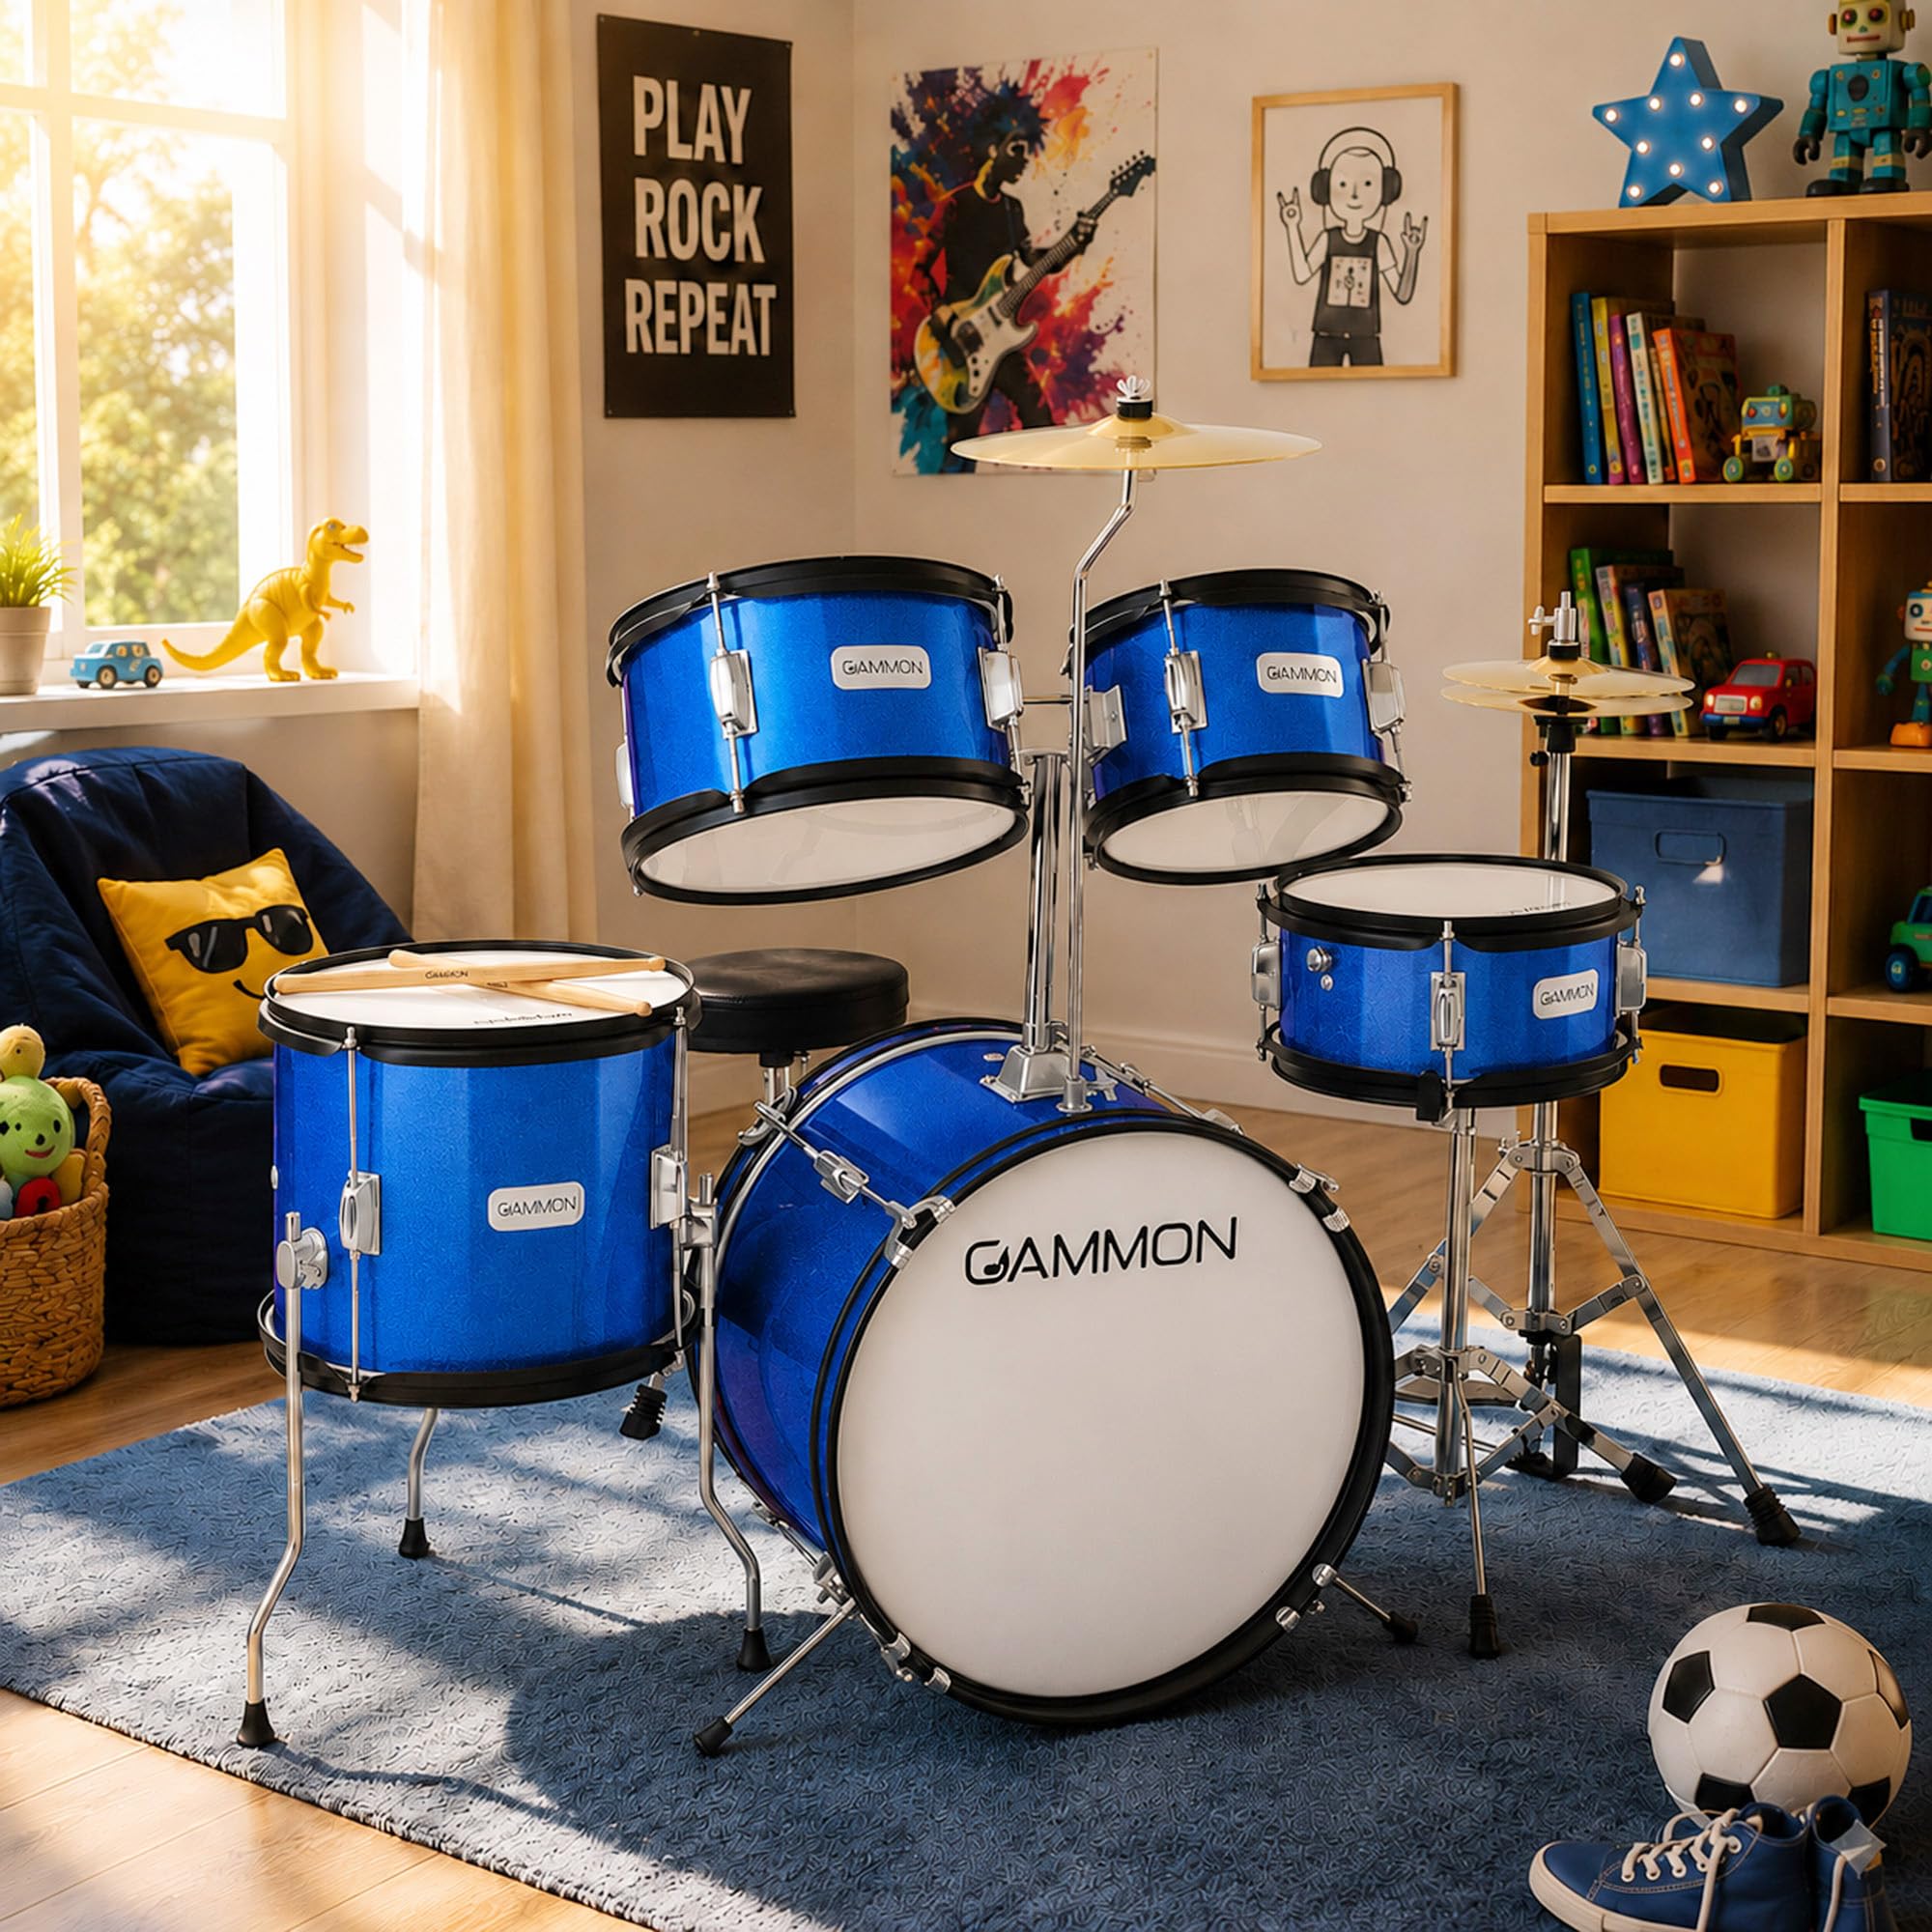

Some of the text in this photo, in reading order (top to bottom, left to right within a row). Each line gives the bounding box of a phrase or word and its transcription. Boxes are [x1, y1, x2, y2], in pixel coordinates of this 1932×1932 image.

[633, 74, 753, 164] PLAY
[635, 177, 766, 264] ROCK
[625, 278, 777, 356] REPEAT
[842, 660, 923, 675] GAMMON
[1267, 666, 1337, 683] GAMMON
[1540, 982, 1594, 1006] GAMMON
[497, 1196, 577, 1217] GAMMON
[965, 1216, 1236, 1285] GAMMON
